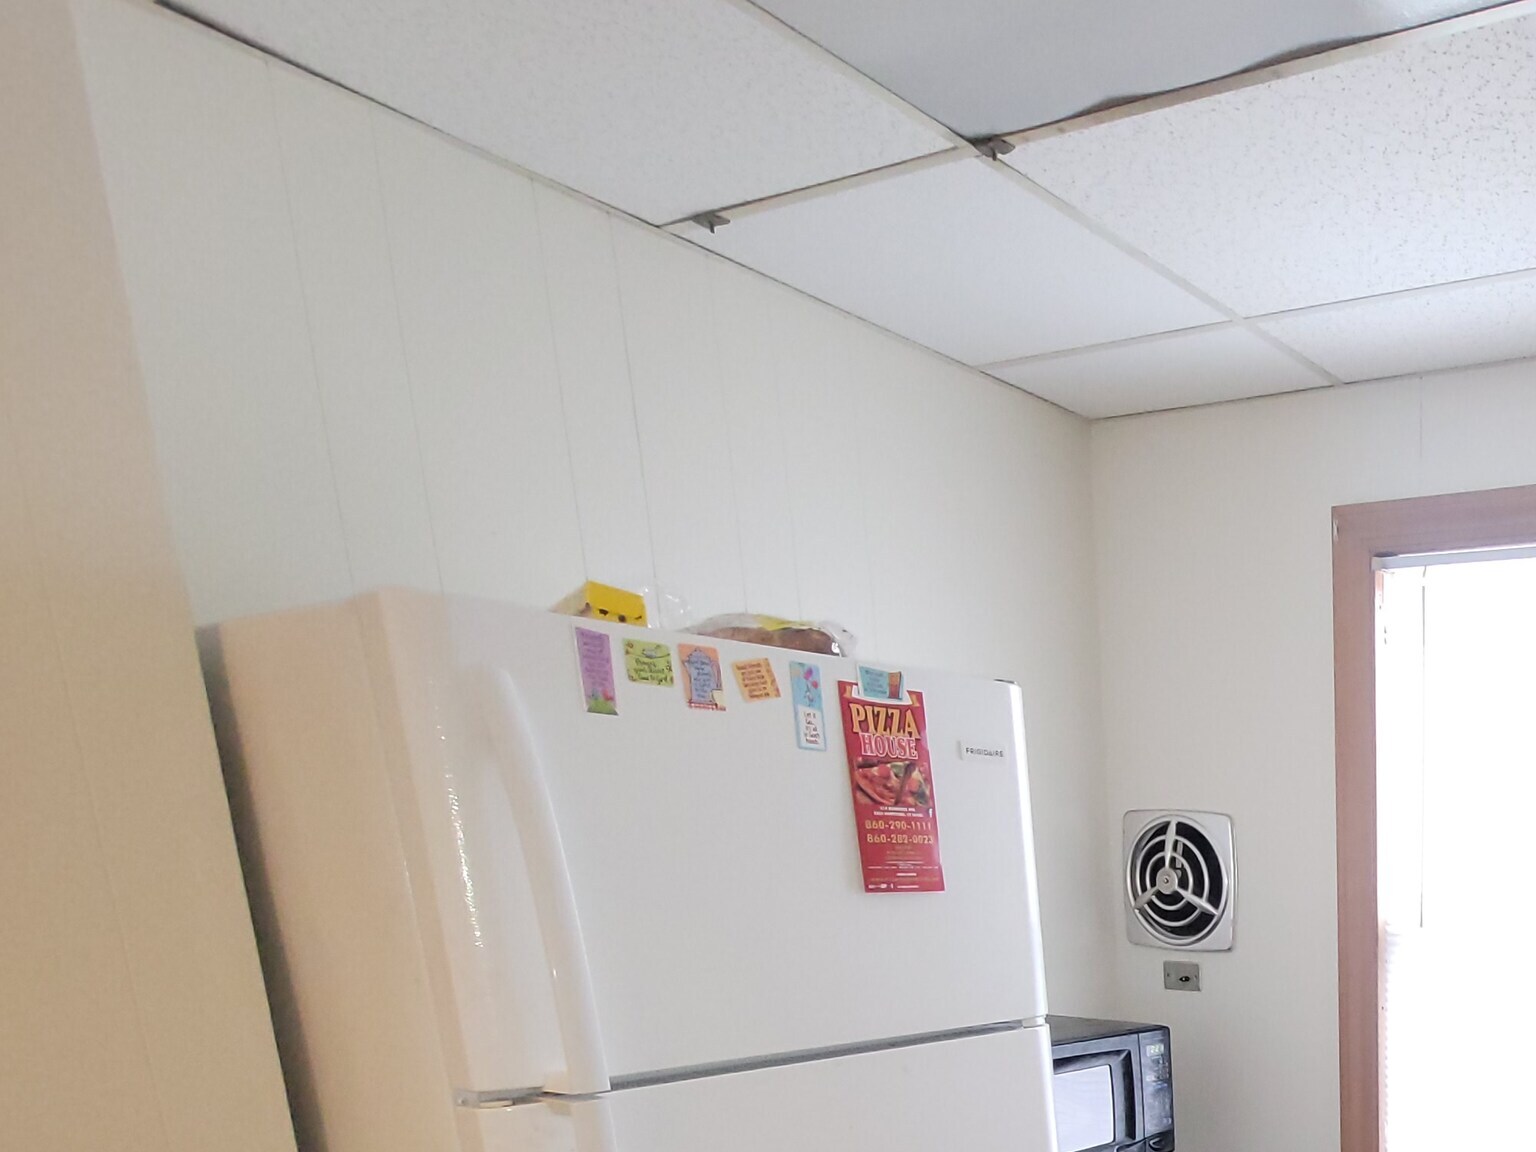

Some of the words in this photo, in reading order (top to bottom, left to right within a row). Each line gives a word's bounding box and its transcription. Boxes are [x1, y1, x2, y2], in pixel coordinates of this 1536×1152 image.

[849, 703, 921, 739] PIZZA
[858, 732, 919, 759] HOUSE
[965, 747, 1004, 758] FRIGIDAIRE
